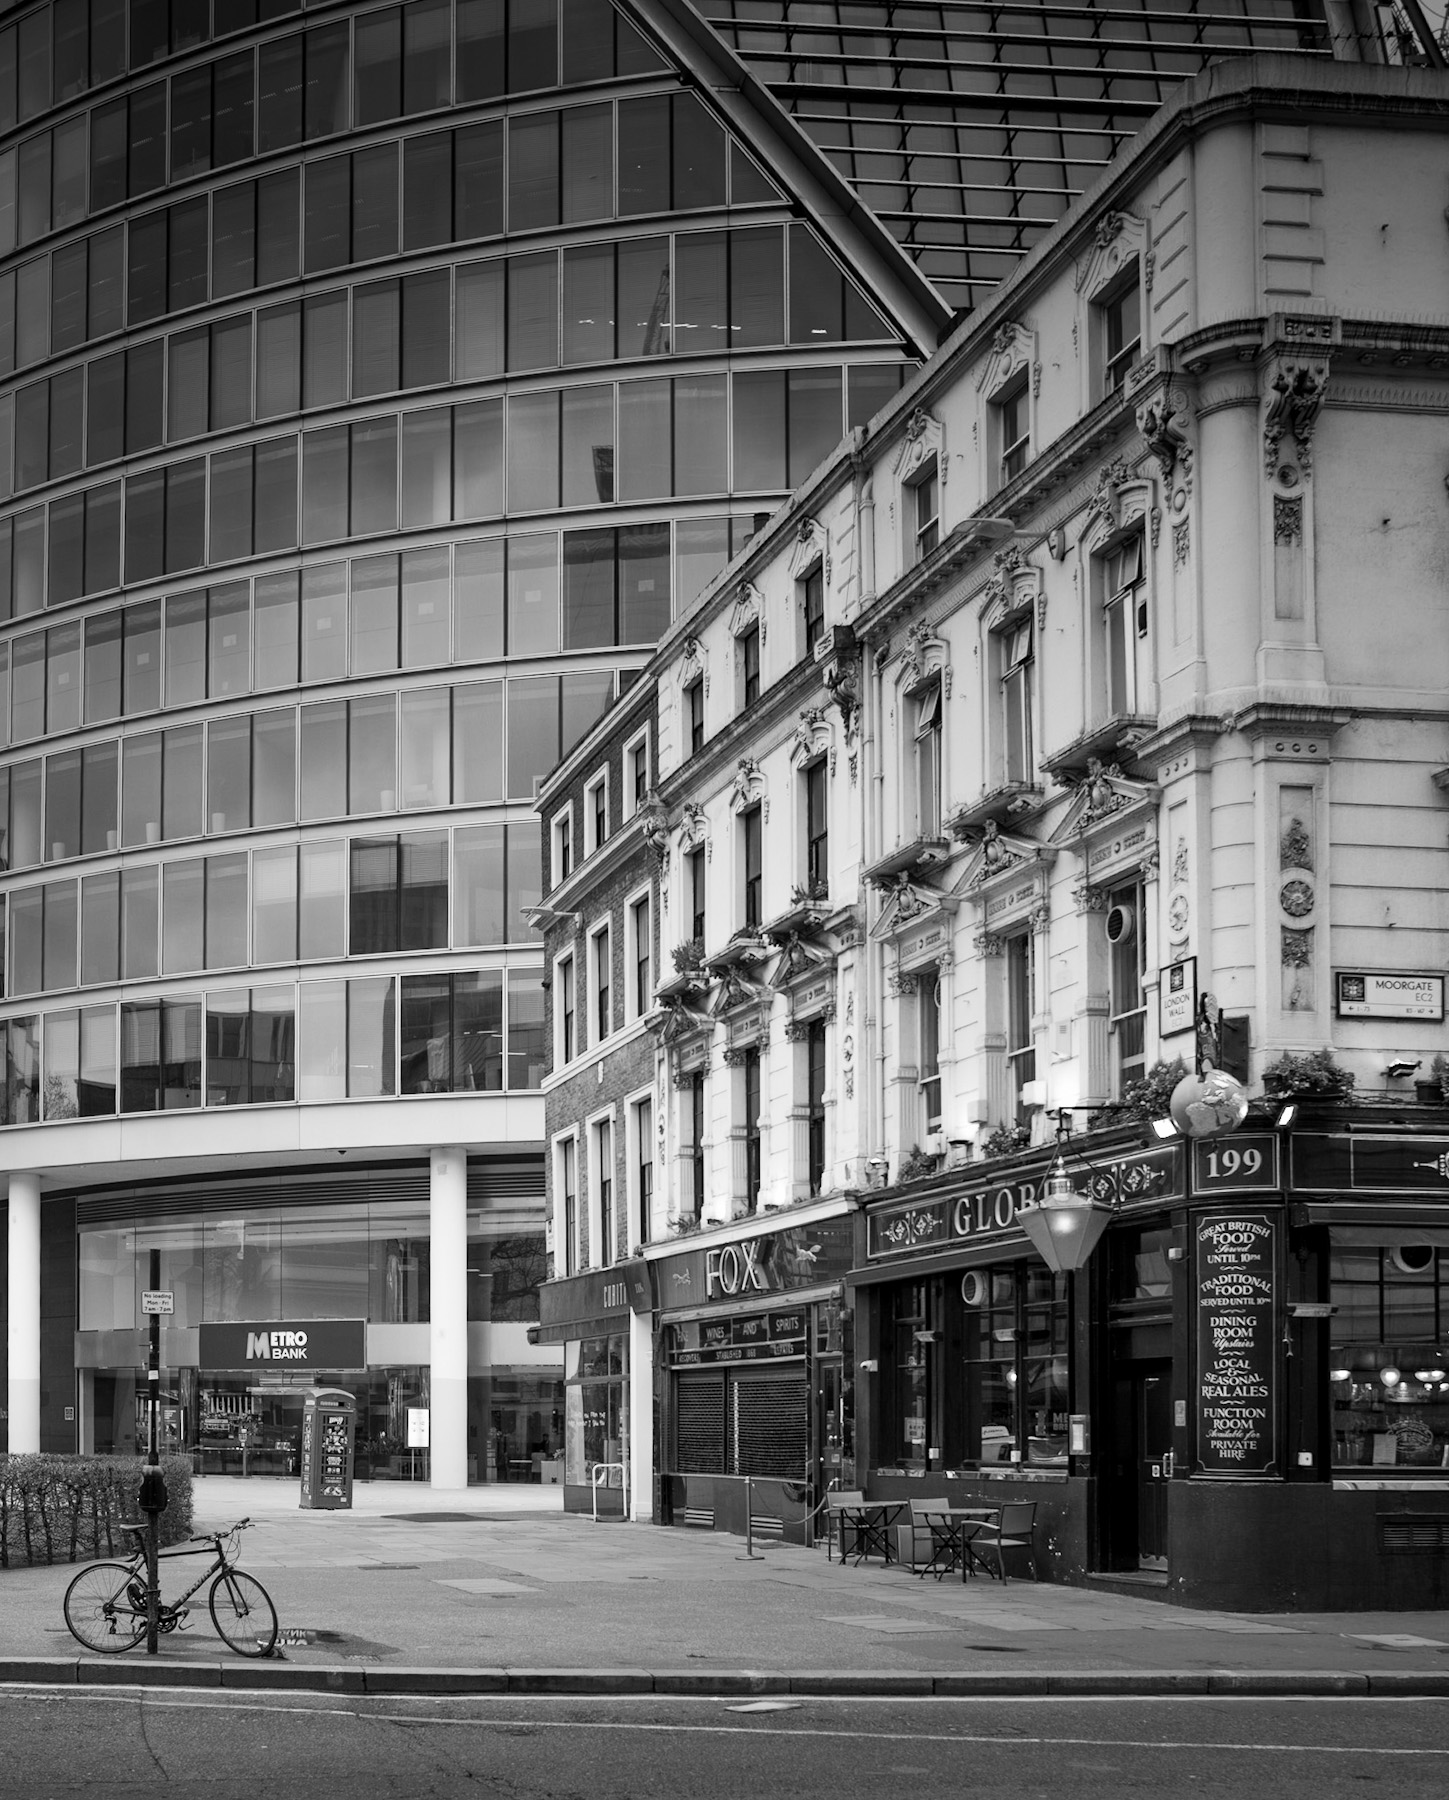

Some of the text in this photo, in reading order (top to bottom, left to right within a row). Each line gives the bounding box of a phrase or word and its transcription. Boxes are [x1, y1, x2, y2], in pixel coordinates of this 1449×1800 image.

[1375, 980, 1433, 991] MOORGATE
[1164, 993, 1190, 1009] LONDON
[1415, 992, 1433, 1002] EC2
[1168, 1005, 1185, 1017] WALL
[1206, 1149, 1262, 1178] 199
[1199, 1221, 1271, 1241] GREAT BRITISH
[1213, 1232, 1255, 1244] FOOD
[1215, 1244, 1252, 1253] Served
[1207, 1254, 1238, 1264] UNTIL
[706, 1241, 761, 1298] FOX
[1200, 1274, 1271, 1293] TRADITIONAL
[1215, 1285, 1253, 1295] FOOD
[1200, 1297, 1229, 1307] SERVED
[1230, 1297, 1255, 1305] UNTIL
[1210, 1316, 1257, 1327] DINING
[706, 1326, 725, 1339] WINES
[742, 1322, 757, 1335] AND
[775, 1316, 799, 1332] SPIRITS
[1213, 1327, 1253, 1338] ROOM
[246, 1331, 308, 1359] METRO
[1212, 1338, 1255, 1350] Upstairs
[272, 1348, 308, 1359] BANK
[1213, 1358, 1251, 1369] LOCAL
[1227, 1368, 1238, 1377] &
[1204, 1372, 1264, 1386] SEASONAL
[1201, 1386, 1268, 1399] REAL ALES
[1203, 1407, 1266, 1418] FUNCTION
[1213, 1419, 1254, 1430] ROOM
[1205, 1429, 1260, 1440] Available for
[1210, 1440, 1257, 1449] PRIVATE
[1219, 1449, 1246, 1461] HIRE
